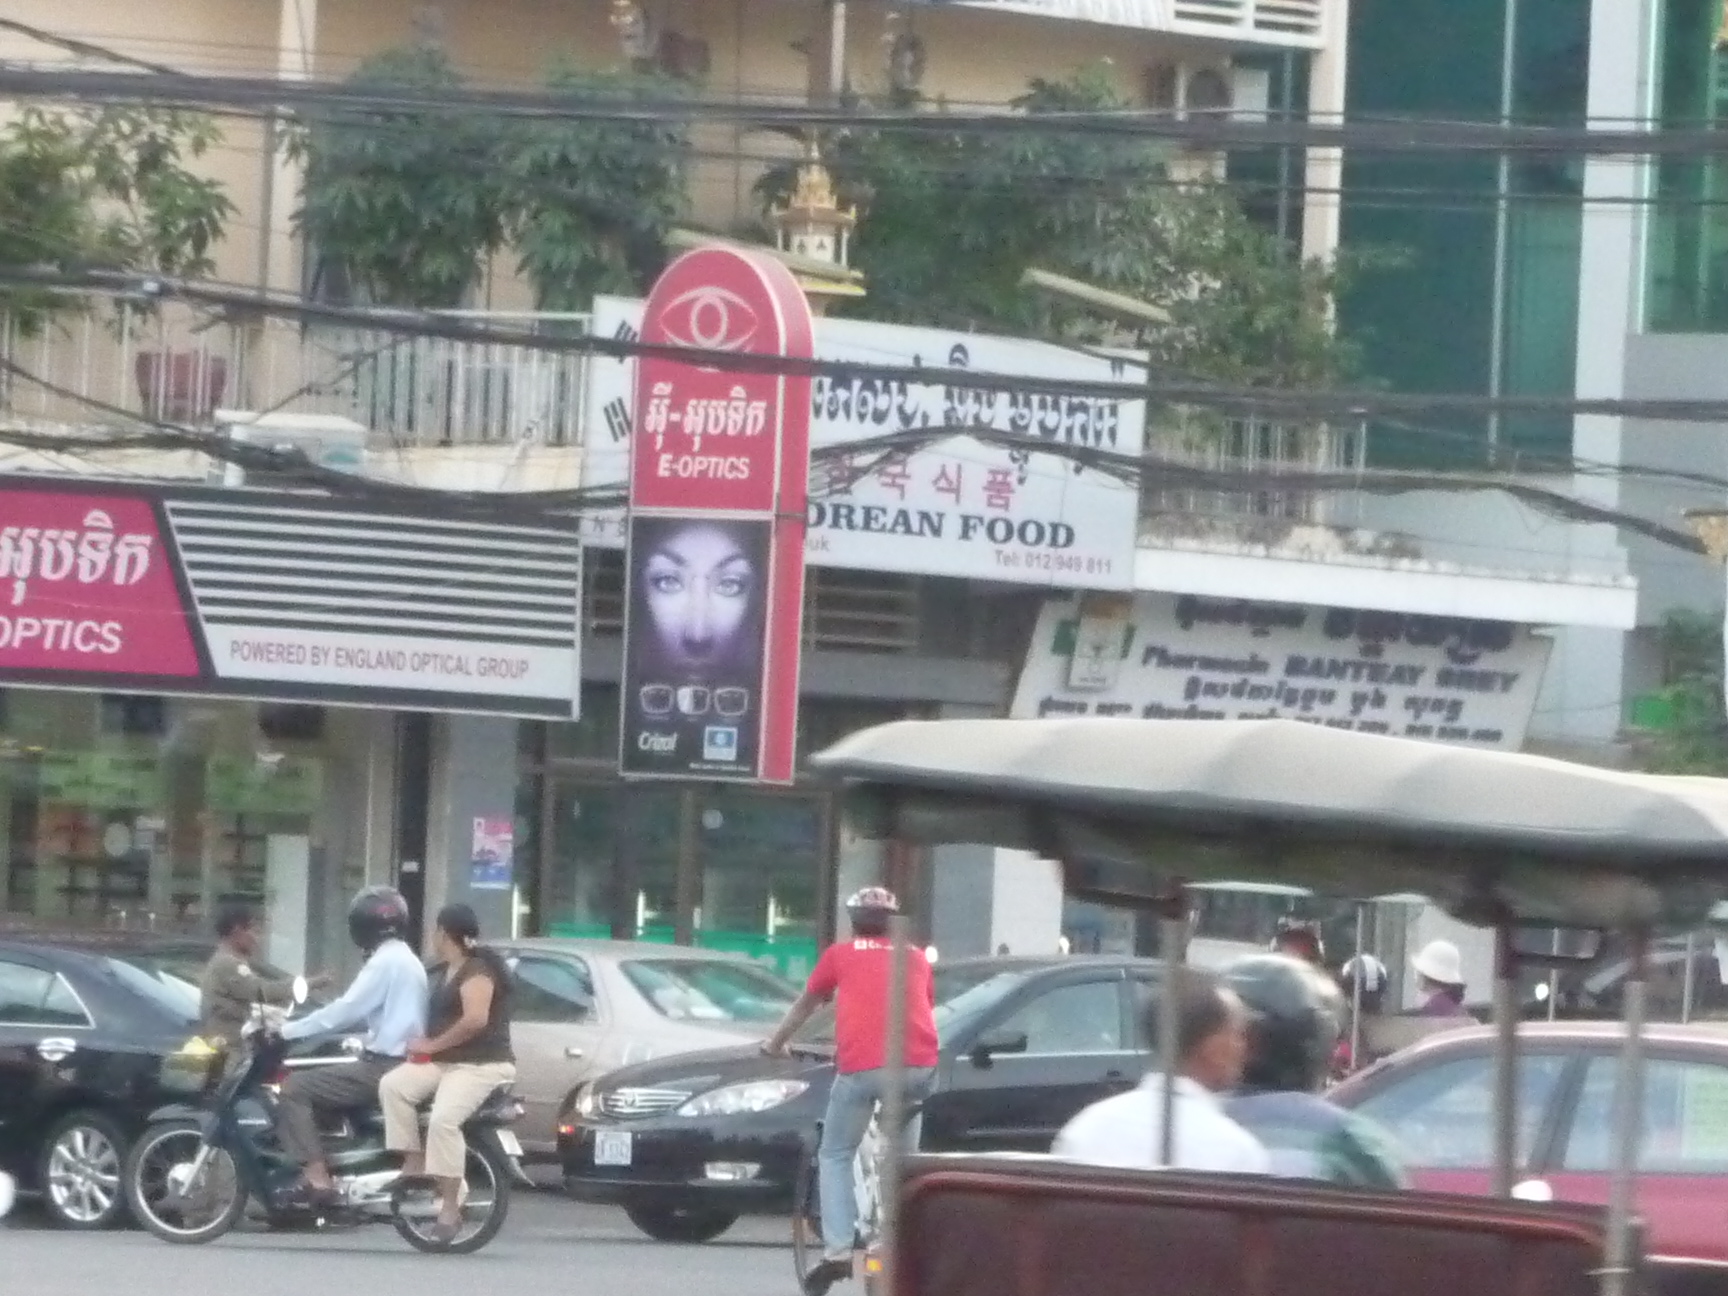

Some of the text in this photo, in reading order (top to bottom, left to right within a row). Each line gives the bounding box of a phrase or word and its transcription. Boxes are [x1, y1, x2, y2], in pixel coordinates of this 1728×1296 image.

[656, 452, 750, 480] E-OPTICS
[804, 500, 1076, 548] OREAN FOOD
[1024, 554, 1051, 571] 012
[229, 639, 530, 680] POWERED BY ENGLAND OPTICAL GROUP
